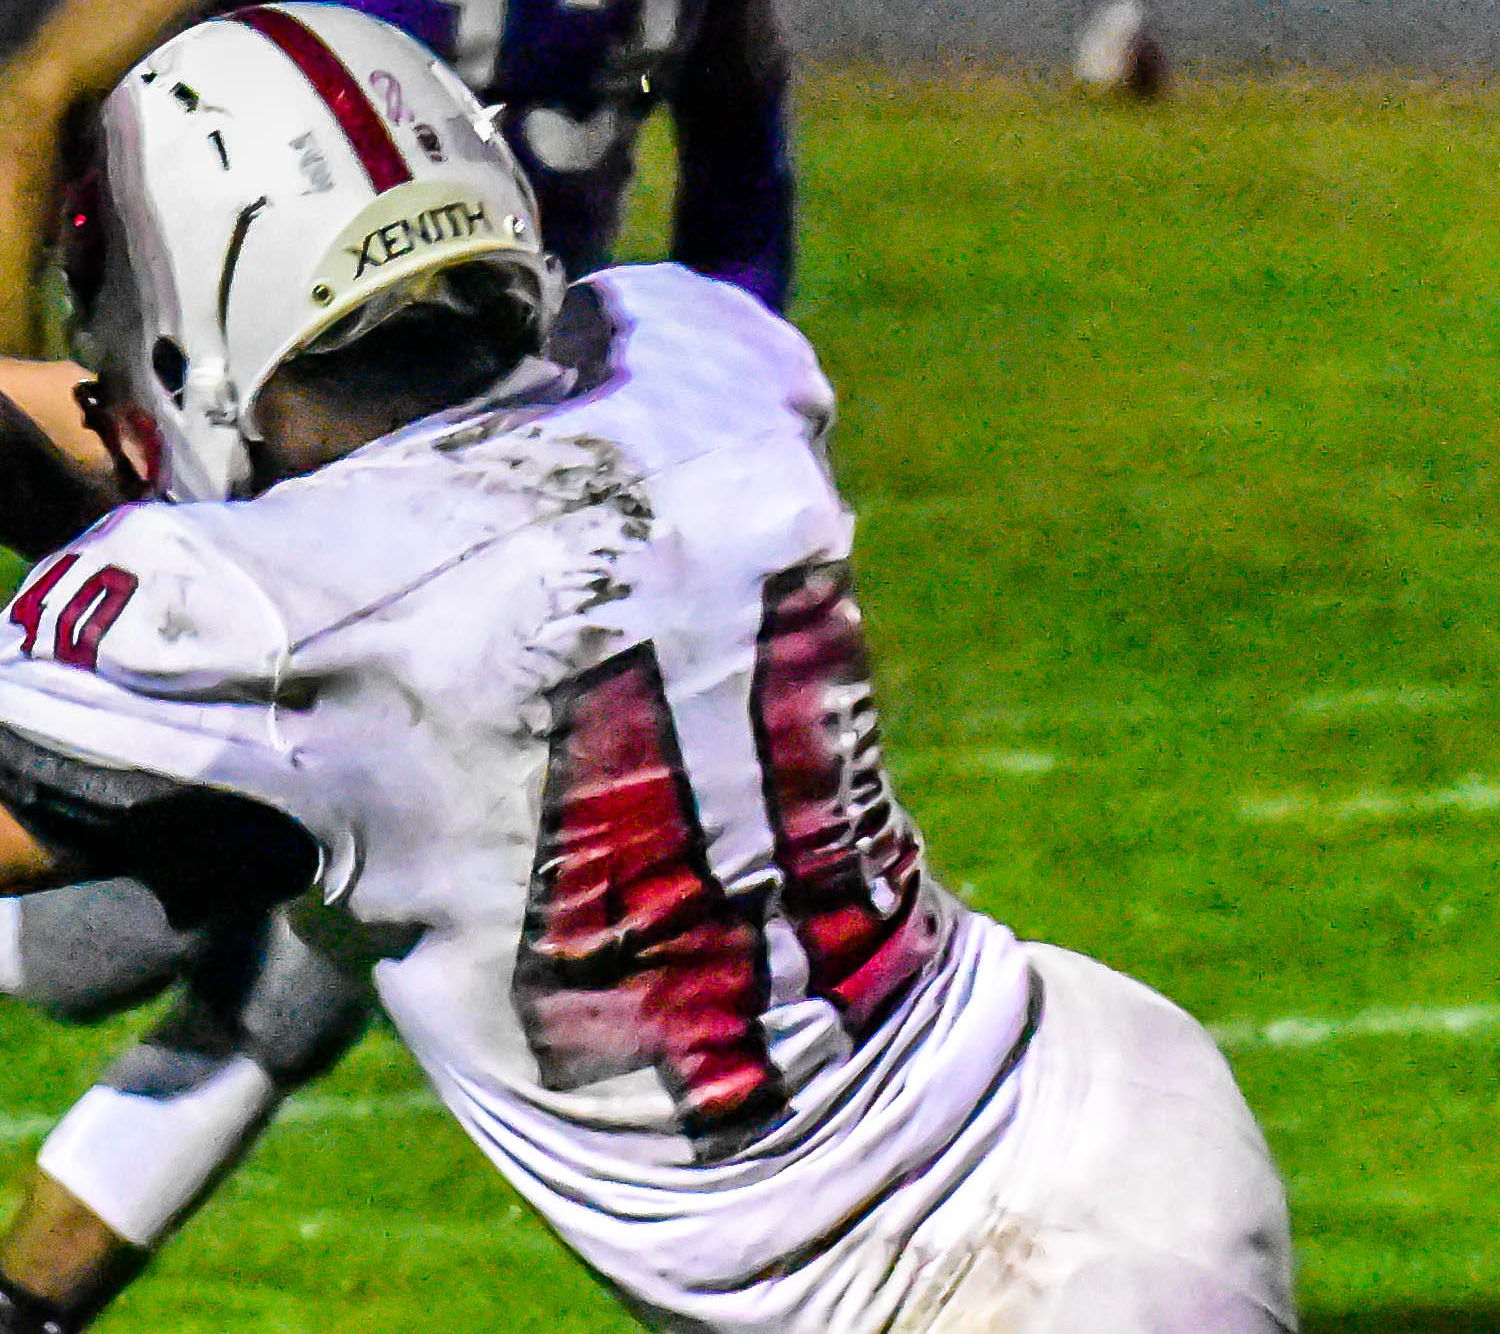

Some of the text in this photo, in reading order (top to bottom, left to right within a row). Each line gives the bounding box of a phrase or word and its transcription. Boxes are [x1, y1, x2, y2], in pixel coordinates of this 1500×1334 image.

[344, 200, 491, 281] XENITH
[9, 553, 139, 673] 40
[511, 557, 922, 1157] 40
